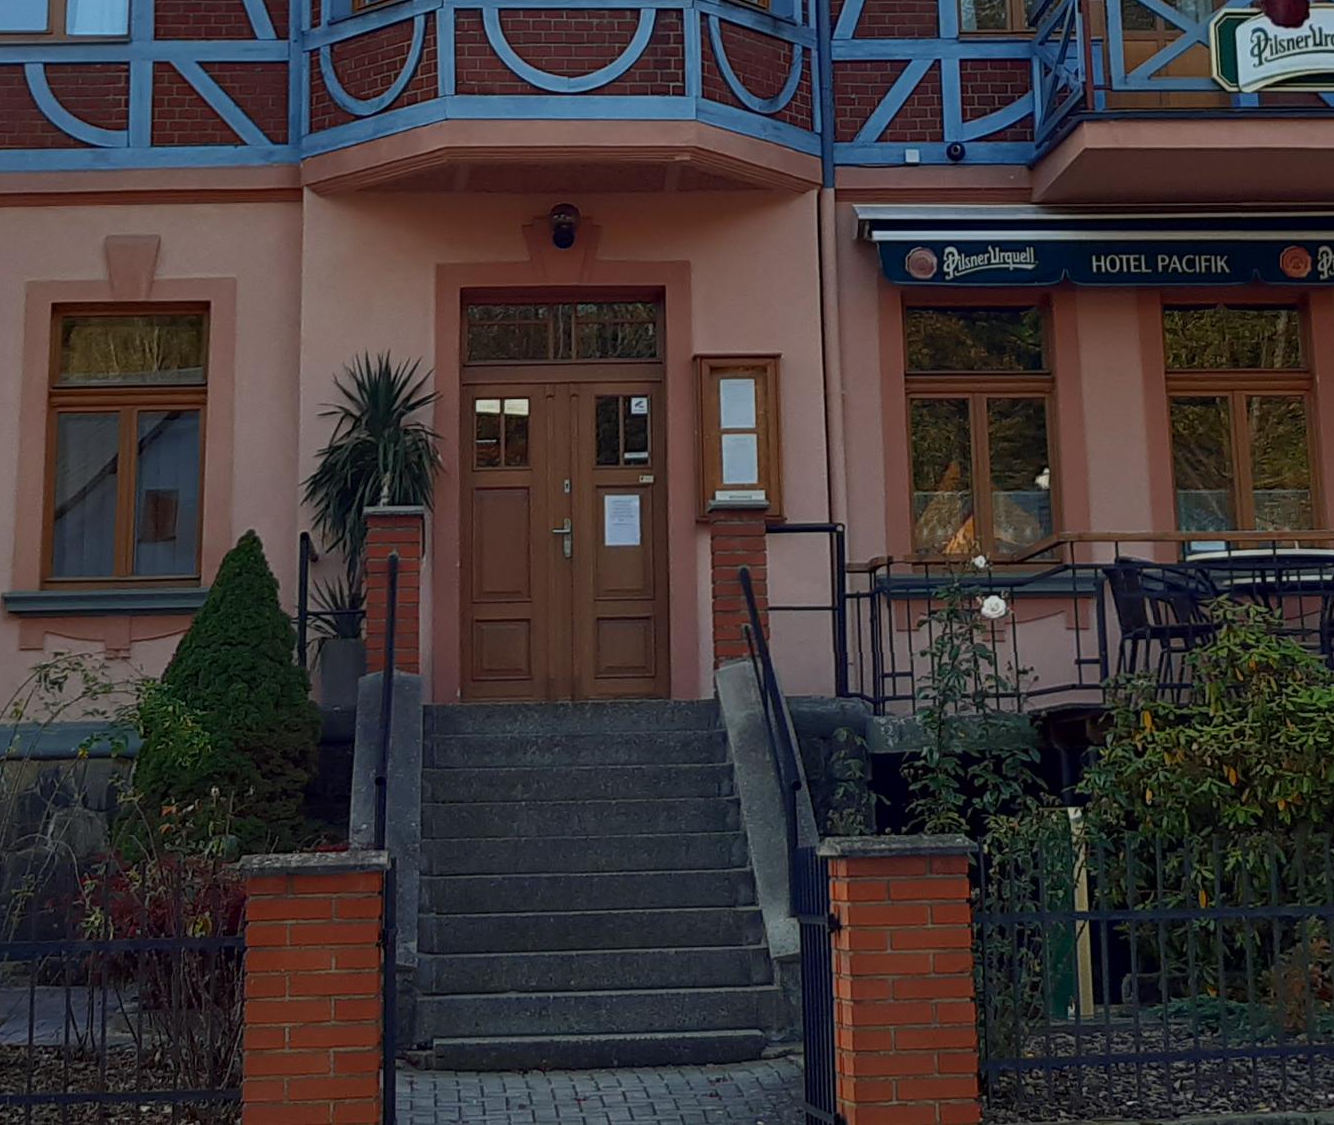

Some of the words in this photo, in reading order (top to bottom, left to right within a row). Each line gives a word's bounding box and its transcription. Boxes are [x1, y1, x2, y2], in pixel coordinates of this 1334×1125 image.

[1250, 26, 1311, 68] Pilsner
[943, 246, 989, 280] Pilsner
[987, 245, 1035, 270] Urquell
[1092, 255, 1152, 273] HOTEL
[1157, 254, 1230, 273] PACIFIK
